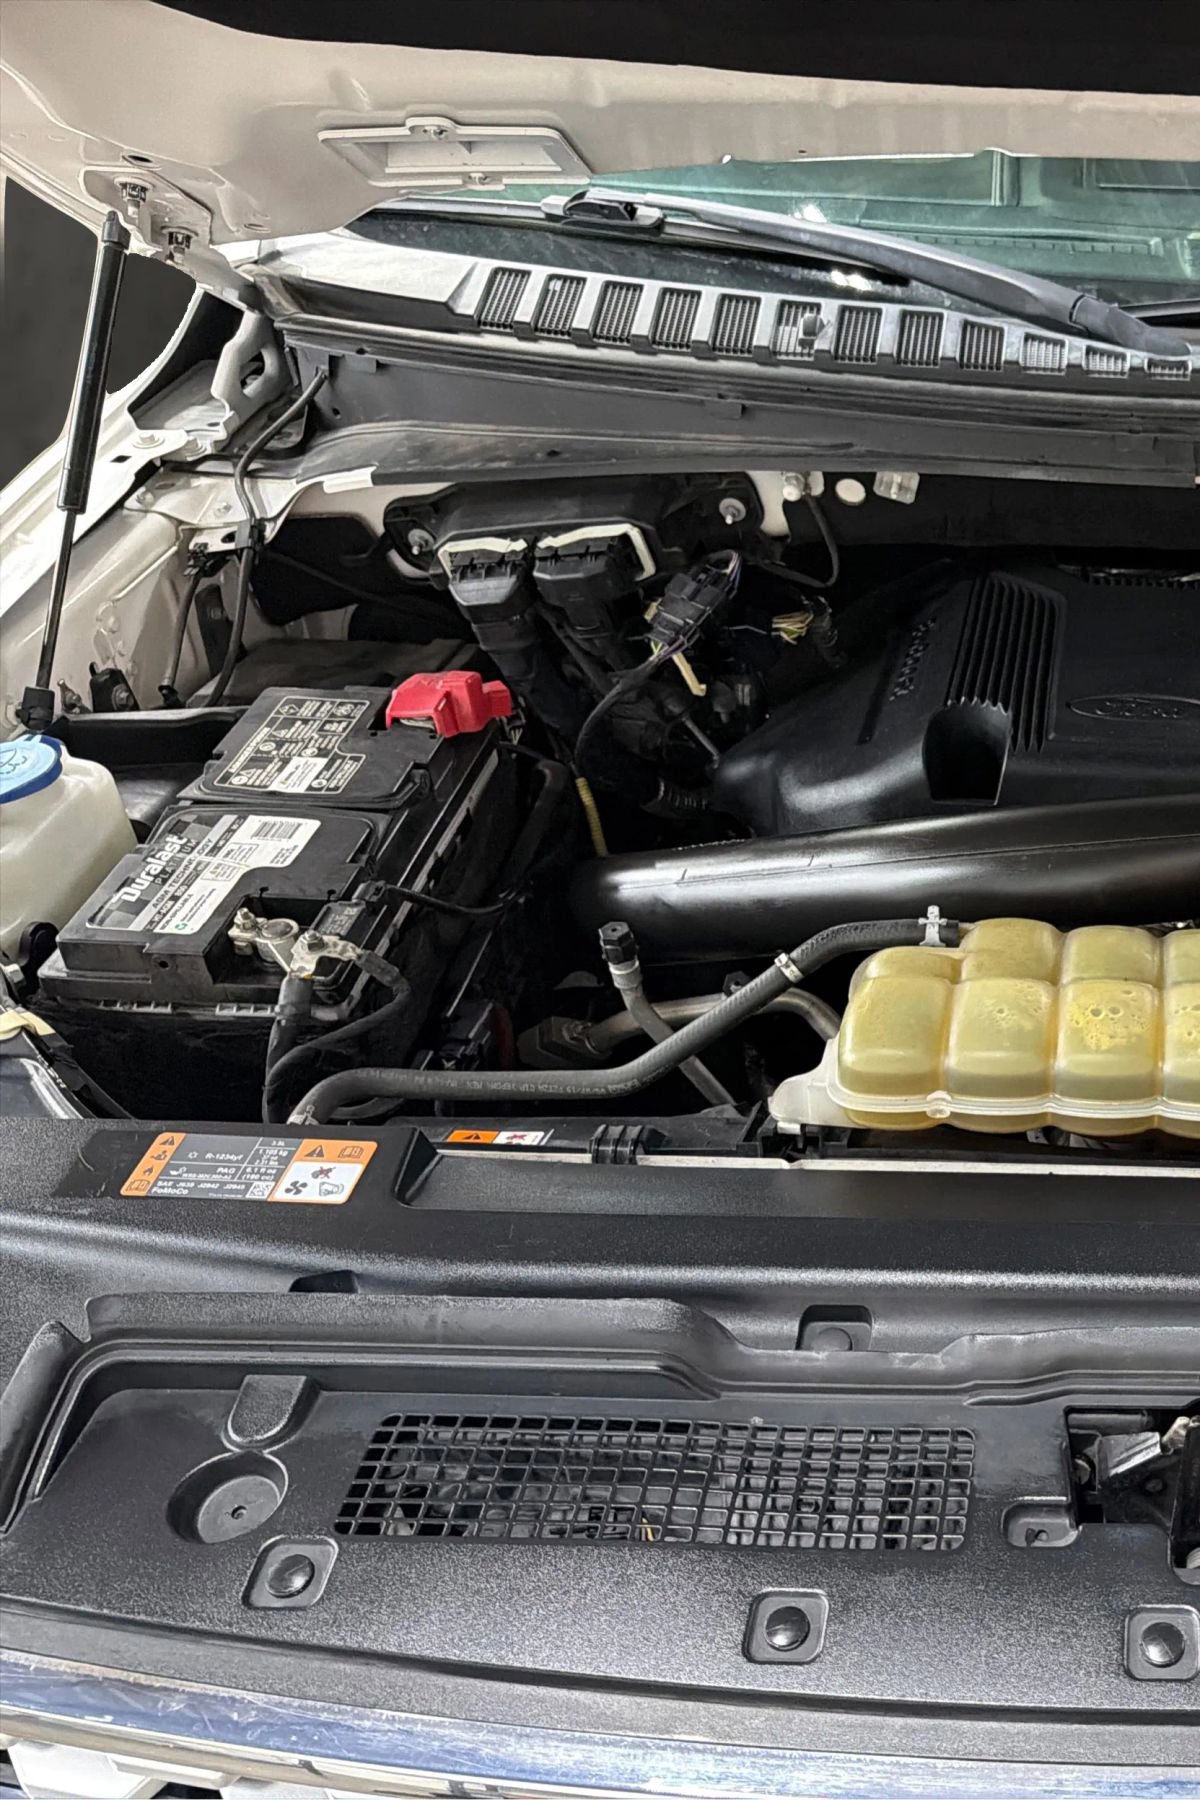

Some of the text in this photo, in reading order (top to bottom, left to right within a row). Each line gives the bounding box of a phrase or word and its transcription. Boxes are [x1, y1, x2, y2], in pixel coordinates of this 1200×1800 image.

[111, 834, 188, 902] Duralast
[155, 839, 199, 885] PLATINUM
[152, 890, 170, 909] AGM
[205, 1153, 244, 1161] R-1234yf
[151, 1187, 189, 1195] FoMoCo
